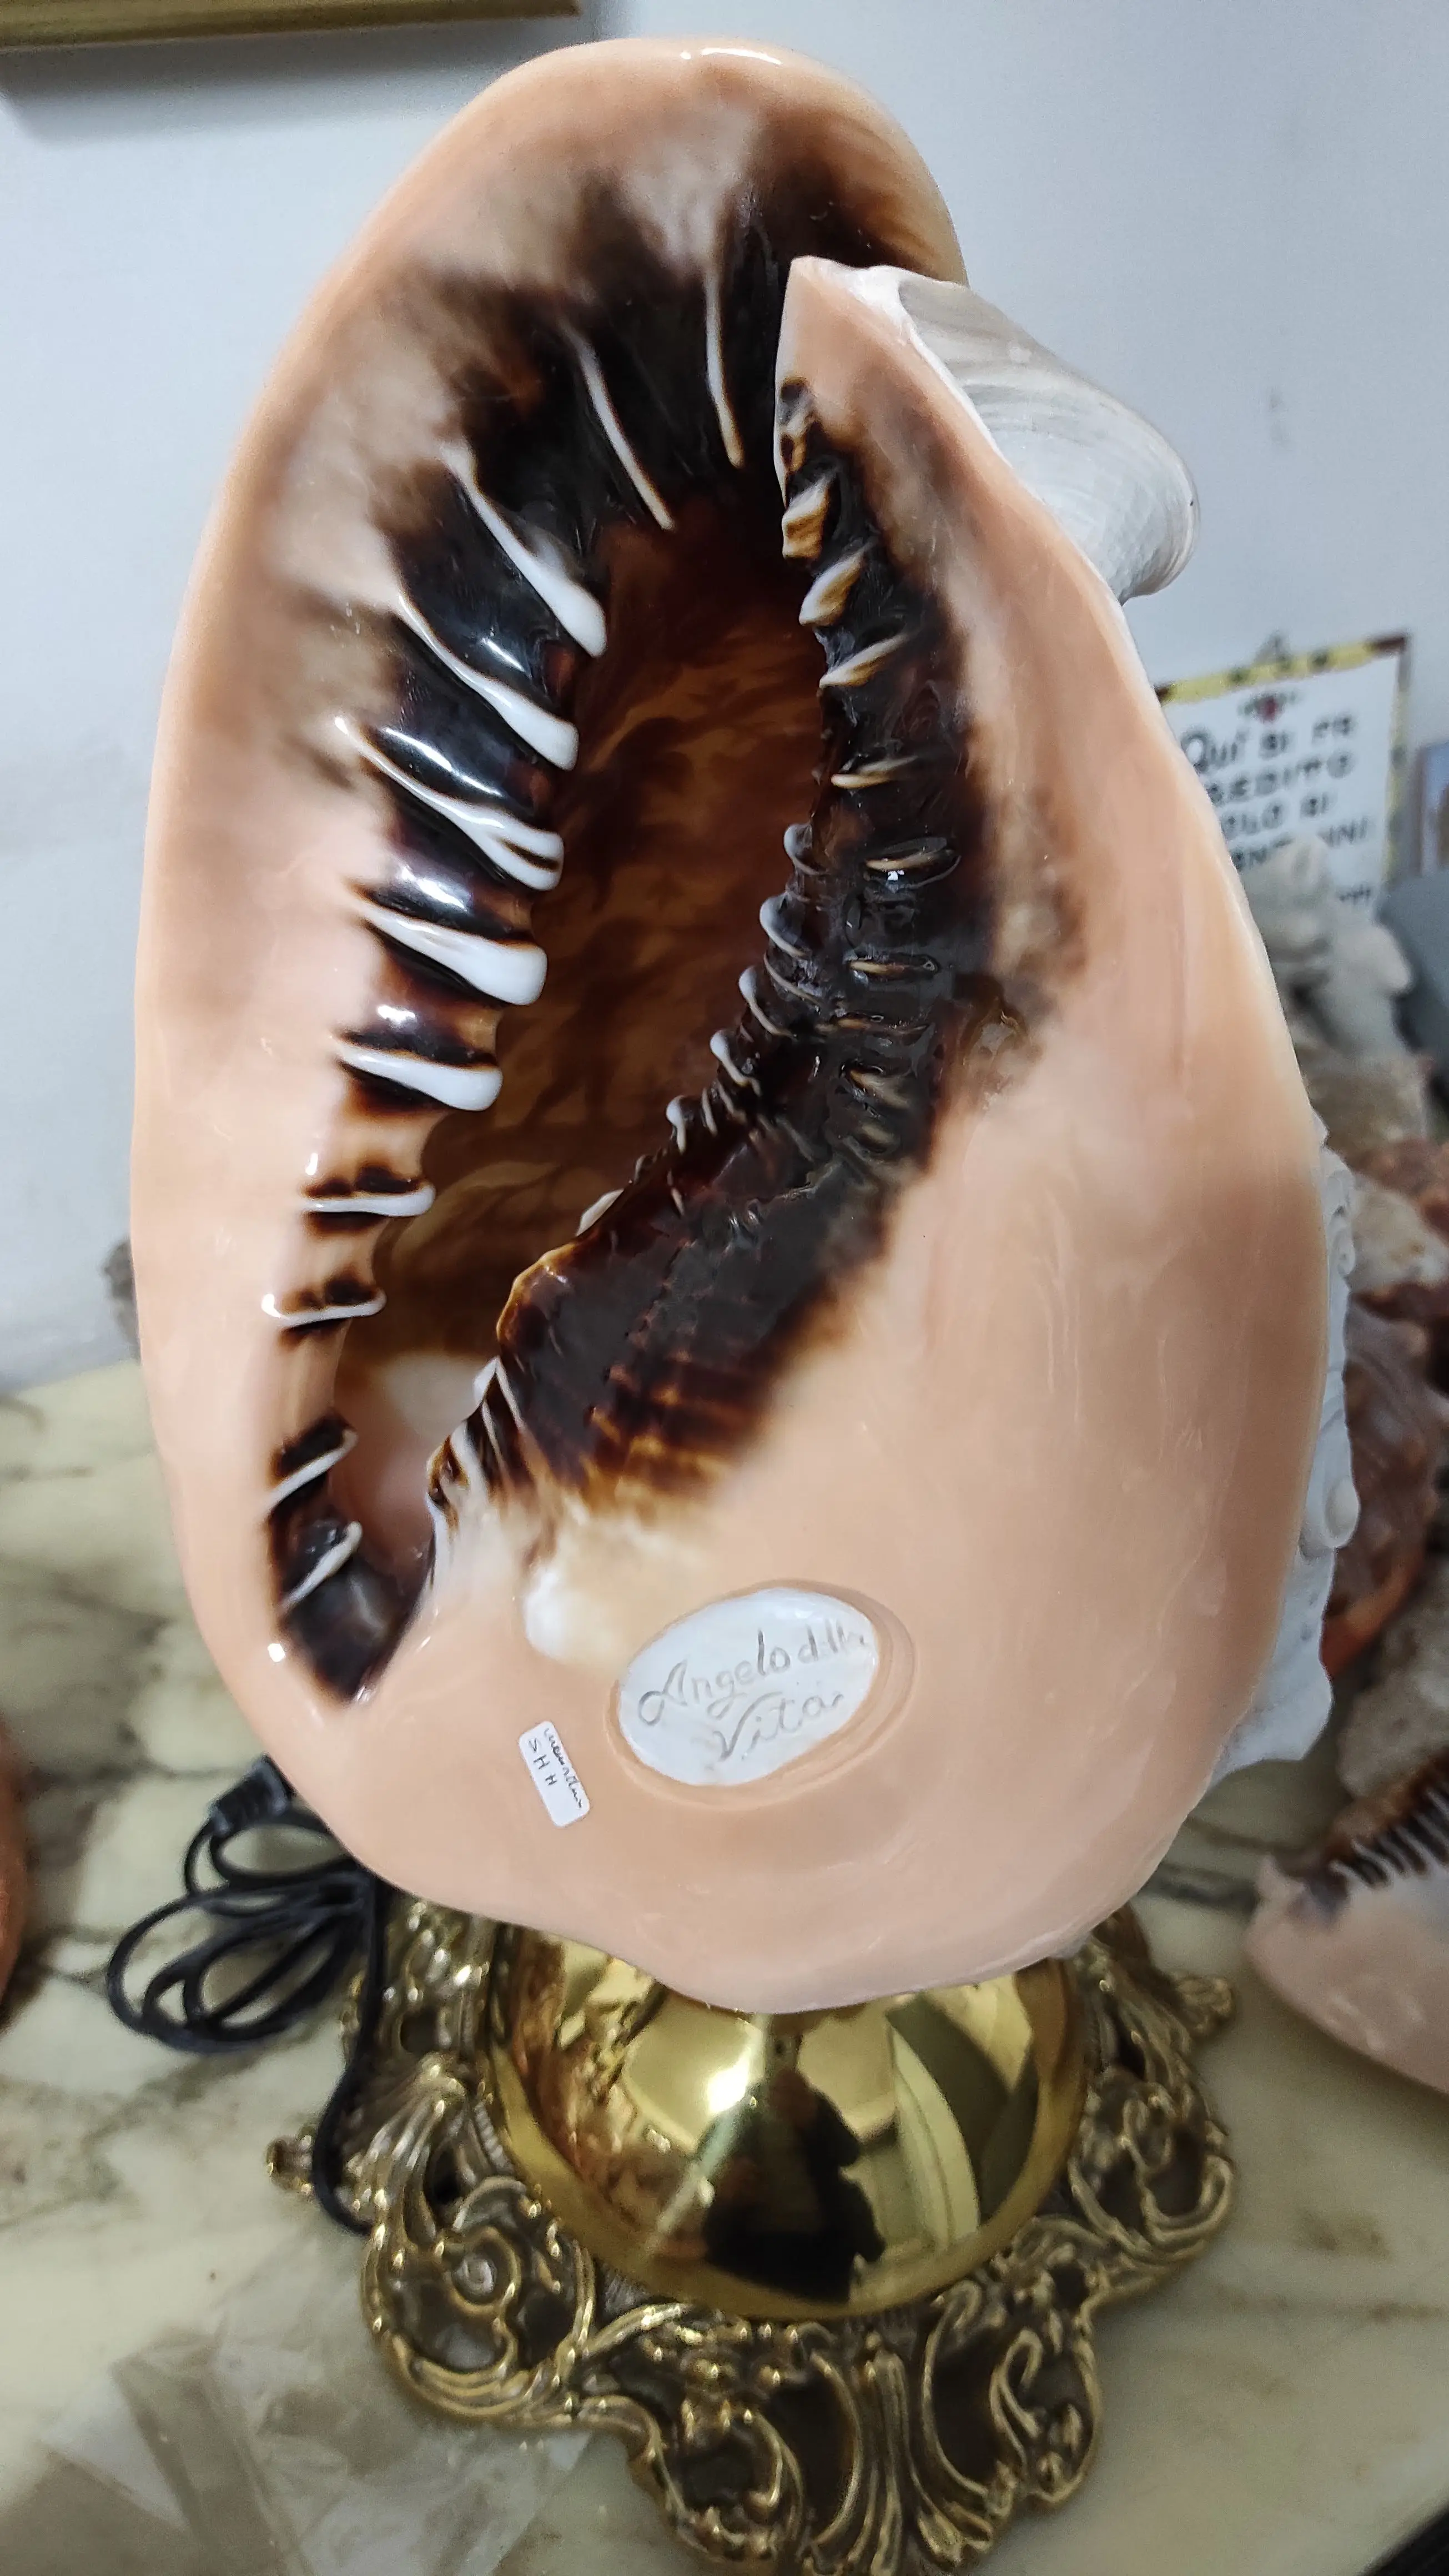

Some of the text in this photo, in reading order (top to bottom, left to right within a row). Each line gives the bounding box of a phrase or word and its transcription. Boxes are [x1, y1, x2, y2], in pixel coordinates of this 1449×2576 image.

[1204, 749, 1355, 806] REDITO
[1221, 803, 1286, 839] OLO
[637, 1628, 791, 1726] Angelo
